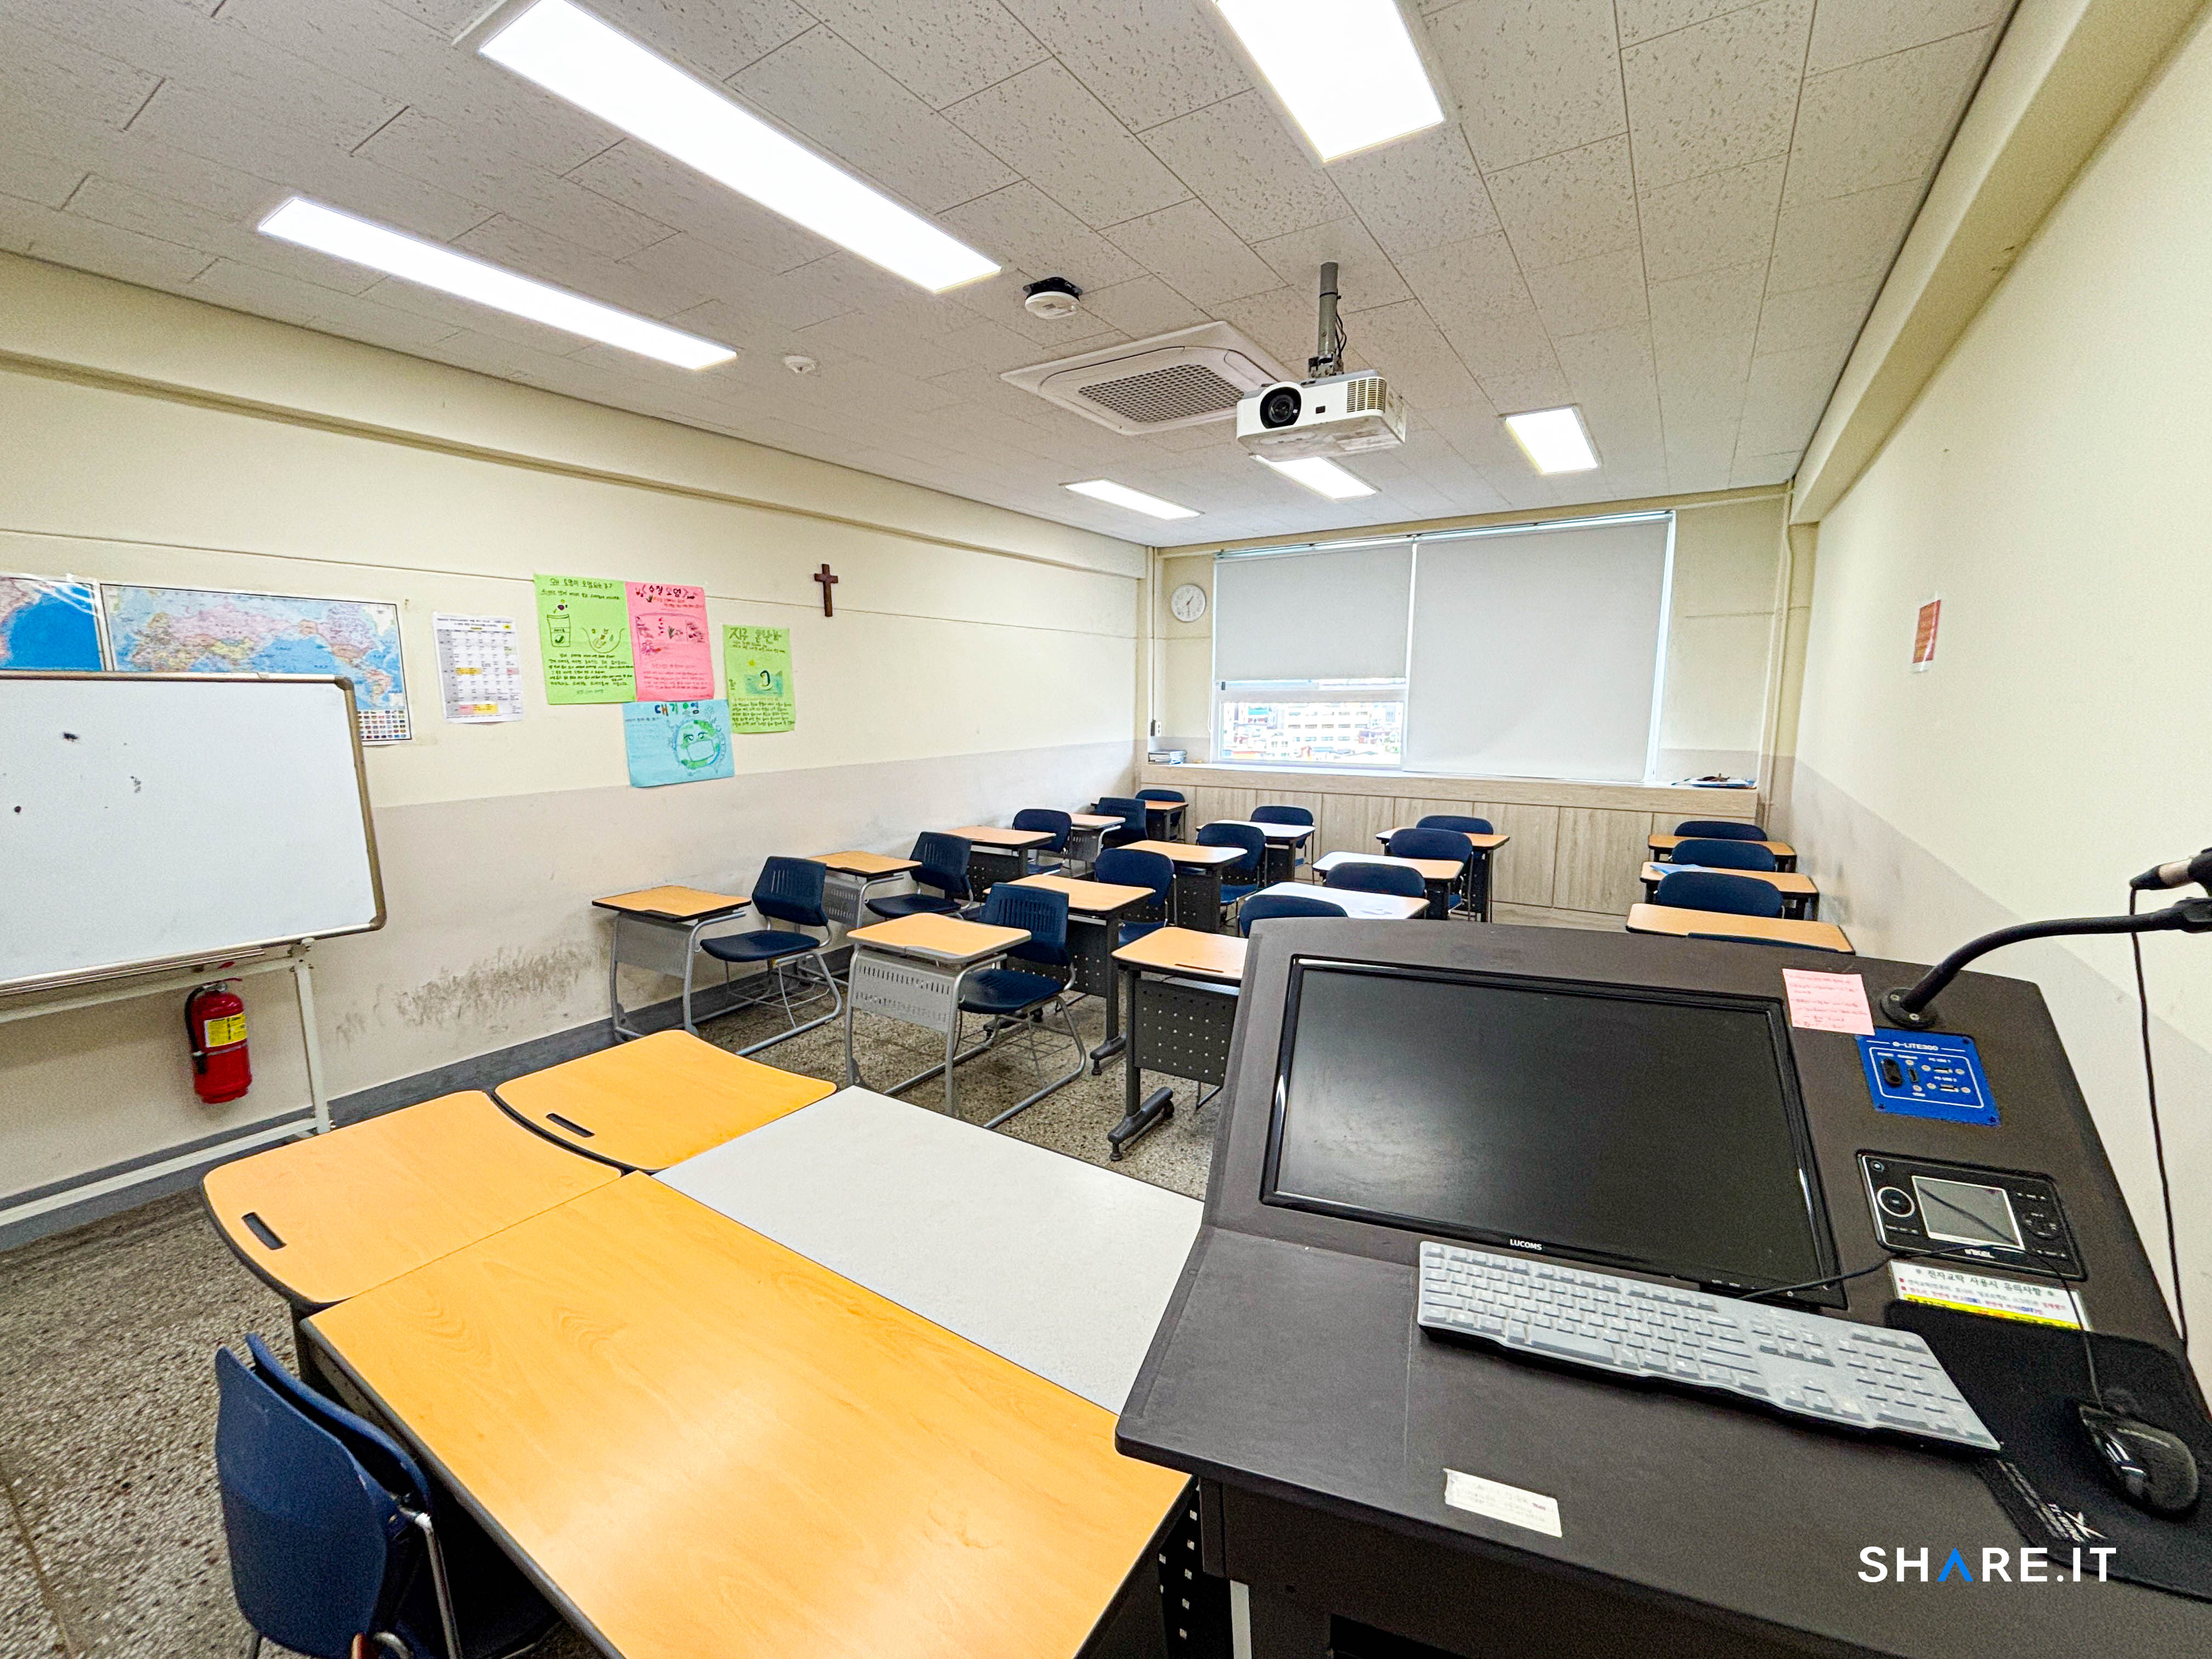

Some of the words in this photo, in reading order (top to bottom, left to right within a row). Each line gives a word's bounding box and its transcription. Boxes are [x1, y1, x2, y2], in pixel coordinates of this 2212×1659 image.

[649, 585, 663, 596] 수질
[666, 586, 681, 597] 오염
[729, 627, 748, 641] 지구
[654, 702, 678, 716] 대기
[682, 701, 699, 715] 오염
[1510, 1239, 1543, 1251] LUCOMS
[1927, 1269, 1965, 1283] 전자교탁
[1970, 1276, 1998, 1289] 사용시
[2004, 1282, 2041, 1296] 유의사항
